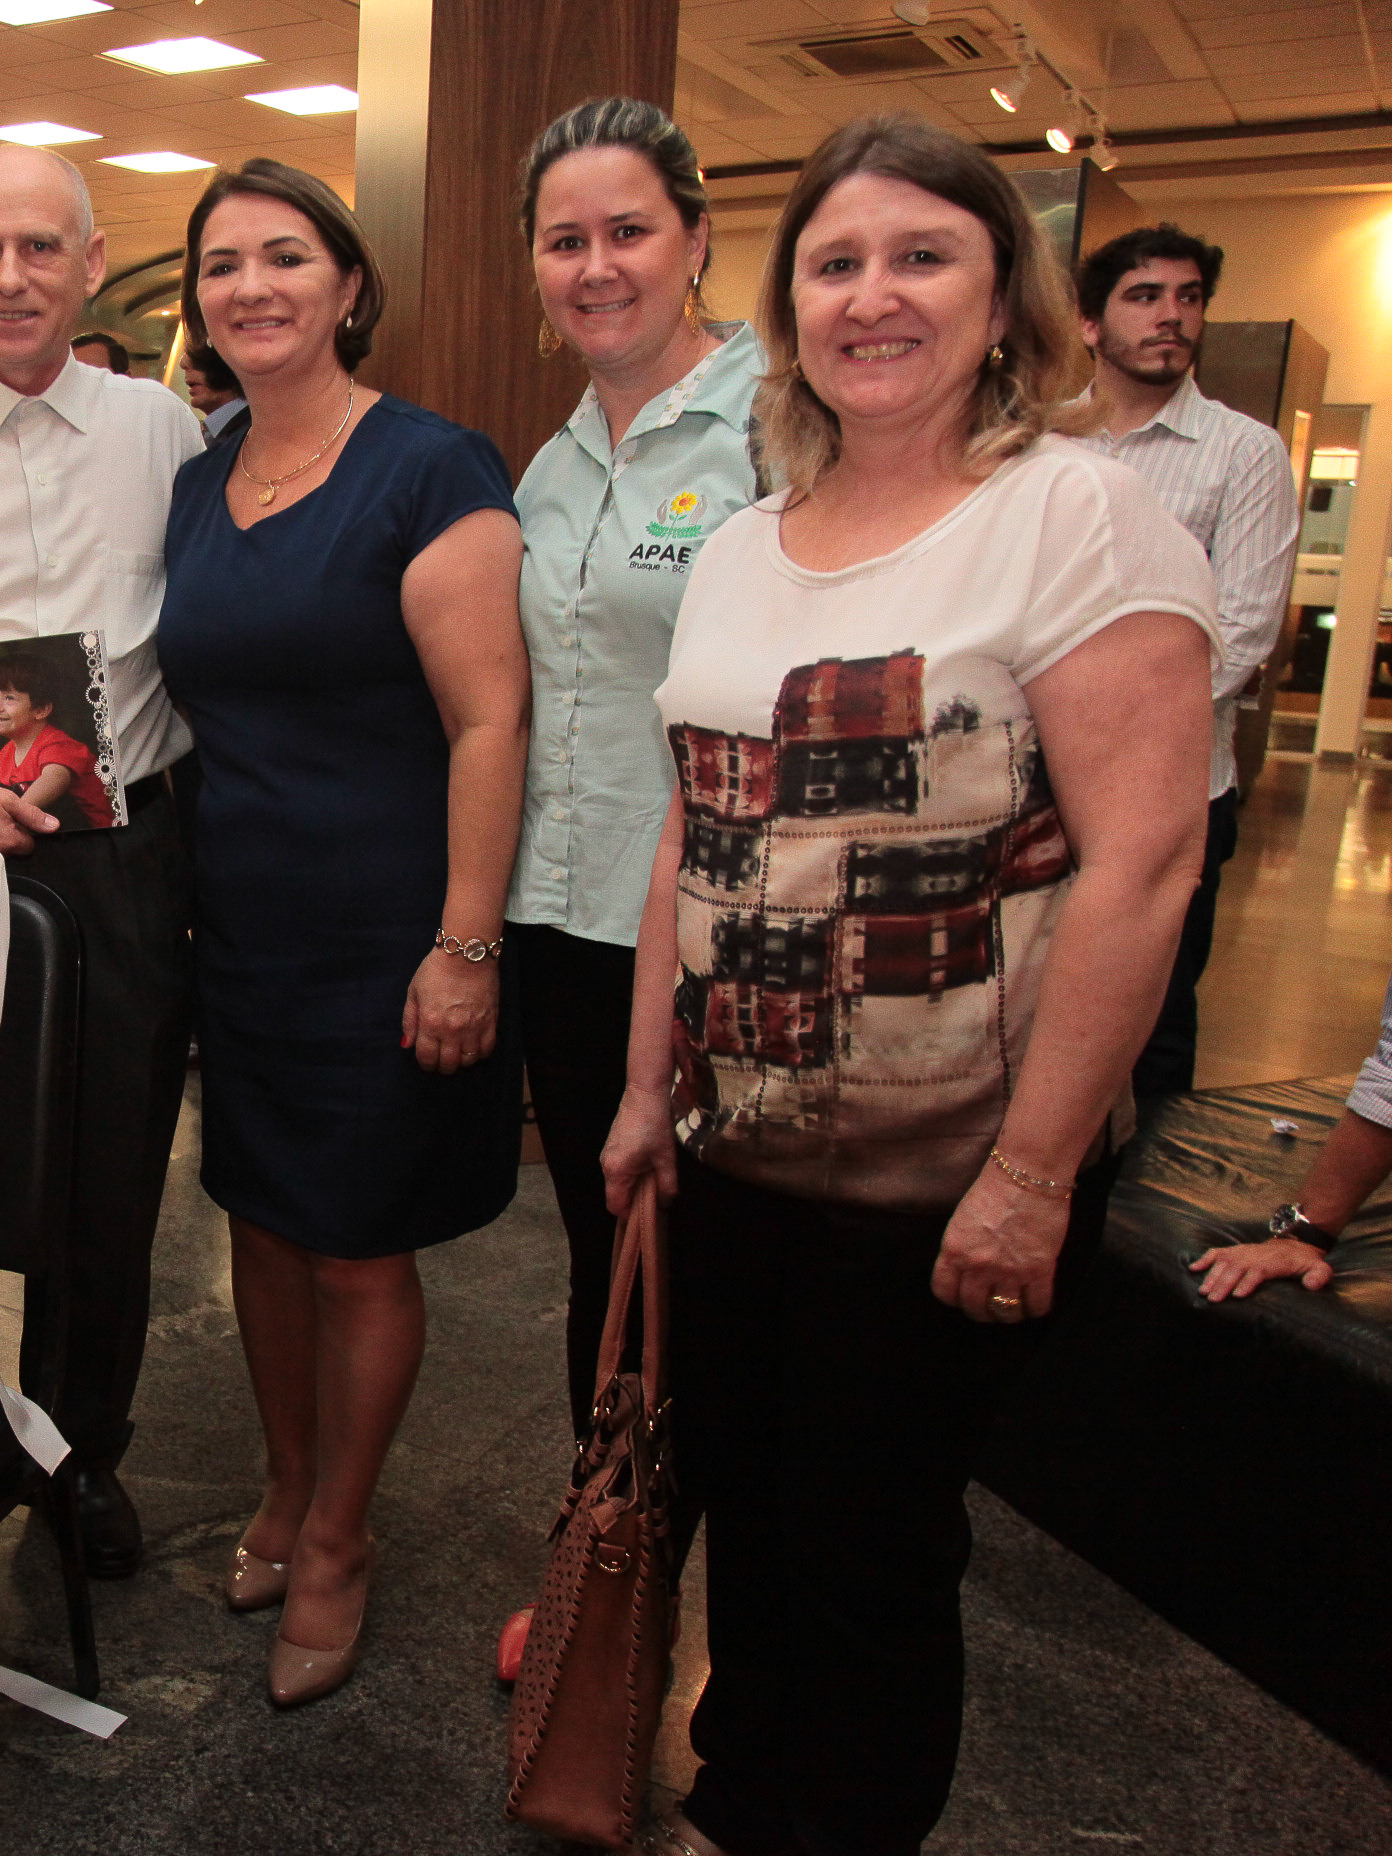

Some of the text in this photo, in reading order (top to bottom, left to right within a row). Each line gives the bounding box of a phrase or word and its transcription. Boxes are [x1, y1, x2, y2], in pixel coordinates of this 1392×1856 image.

[629, 543, 692, 565] APAE
[629, 561, 660, 572] Brusque
[672, 564, 685, 573] SC
